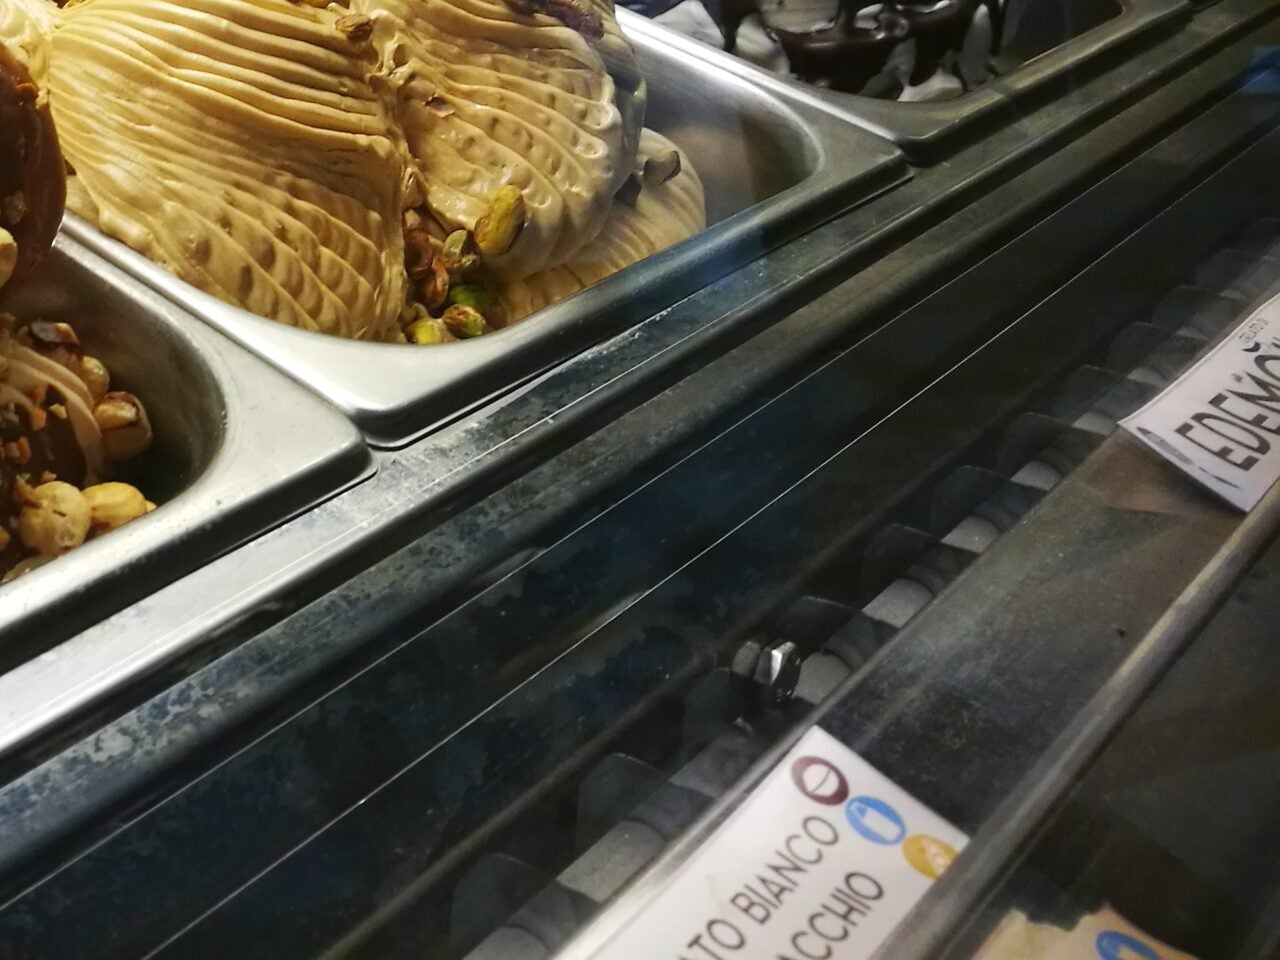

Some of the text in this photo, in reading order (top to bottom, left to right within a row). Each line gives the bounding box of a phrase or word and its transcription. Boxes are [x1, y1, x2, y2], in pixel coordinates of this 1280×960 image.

[679, 815, 839, 960] TO BIANCO
[777, 871, 884, 960] CCHIO
